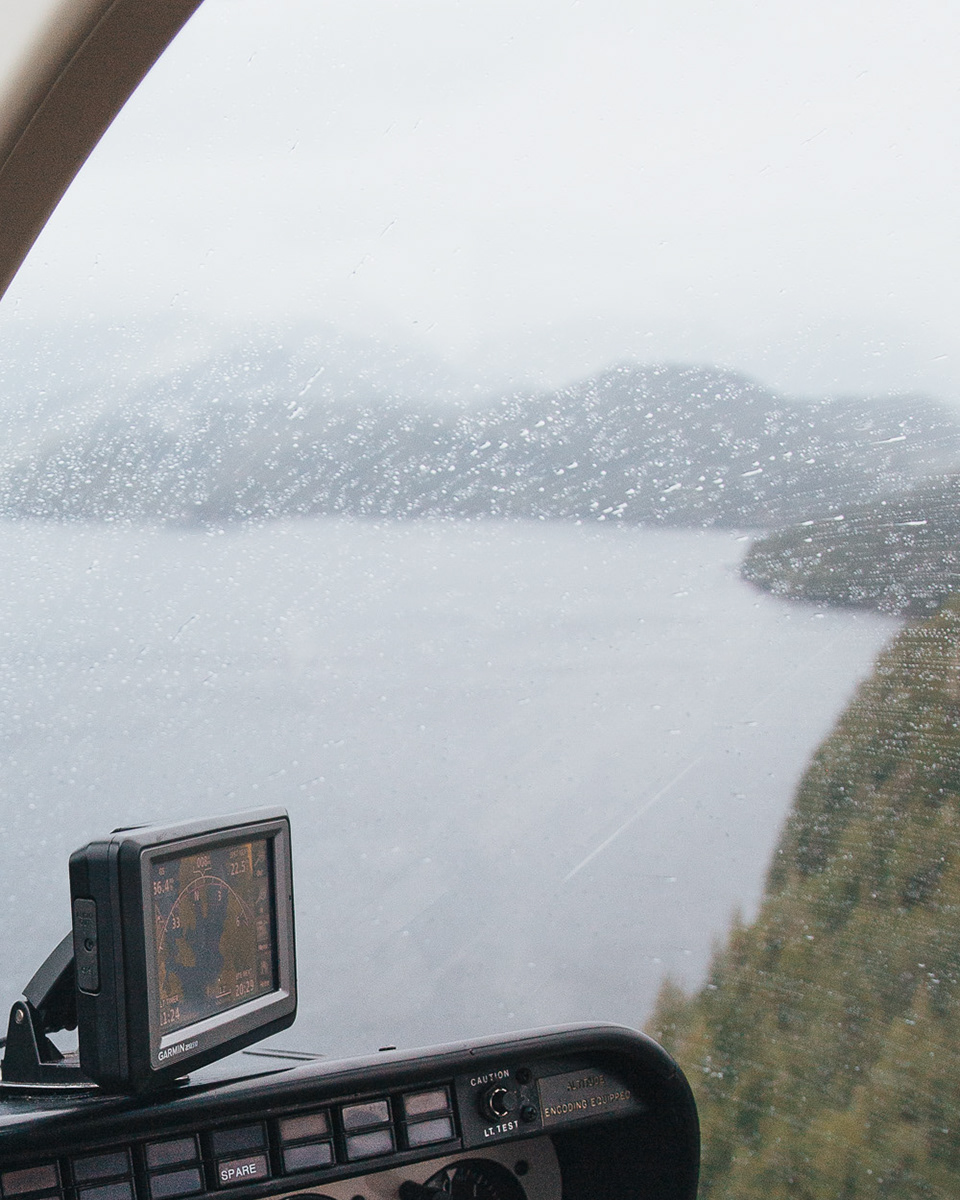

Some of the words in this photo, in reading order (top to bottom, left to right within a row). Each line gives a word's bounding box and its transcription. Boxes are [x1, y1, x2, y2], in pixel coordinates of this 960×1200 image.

[158, 1043, 185, 1061] GARMIN
[470, 1069, 510, 1087] CAUTION
[544, 1100, 588, 1118] ENCODING
[591, 1090, 631, 1107] EQUIPPED
[221, 1163, 257, 1182] SPARE
